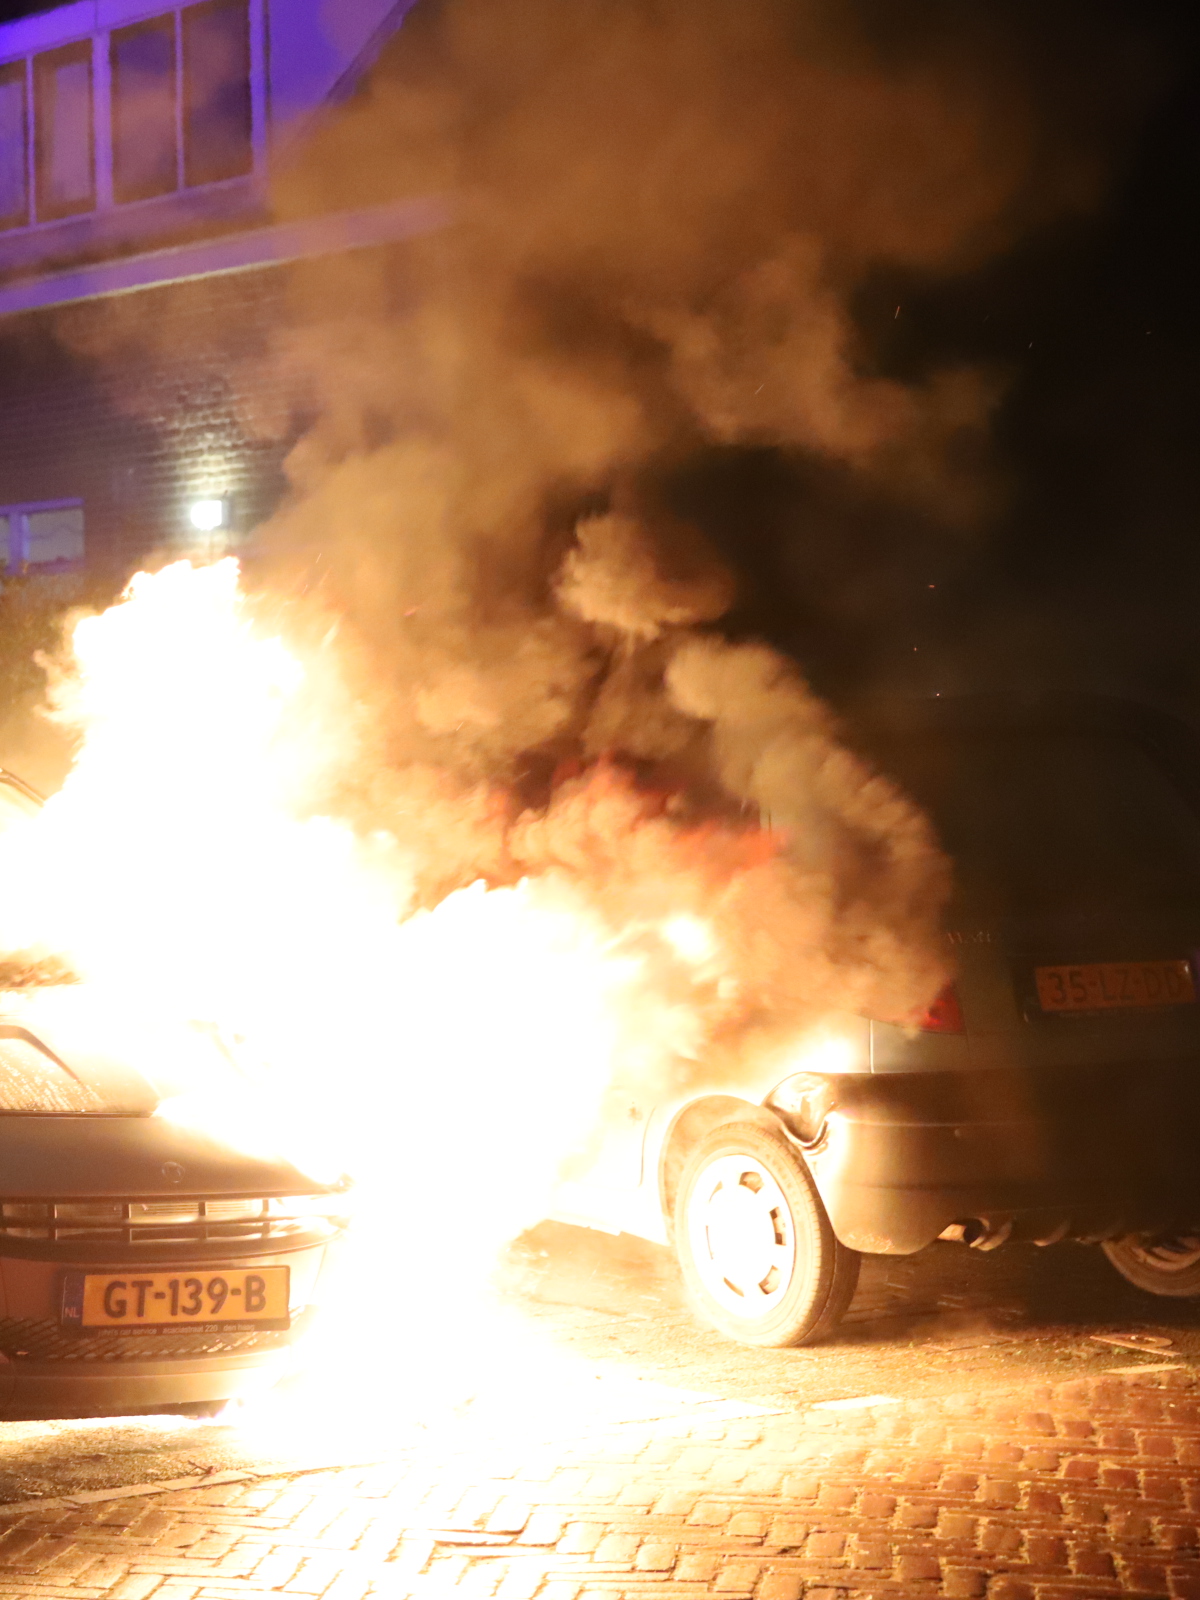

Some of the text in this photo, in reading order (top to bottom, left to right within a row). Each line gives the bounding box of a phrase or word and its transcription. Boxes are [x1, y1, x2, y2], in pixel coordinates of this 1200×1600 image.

[1047, 966, 1185, 1004] 35-LZ-DD
[103, 1274, 267, 1319] GT-139-B
[64, 1307, 80, 1319] NL
[205, 1323, 218, 1333] 220
